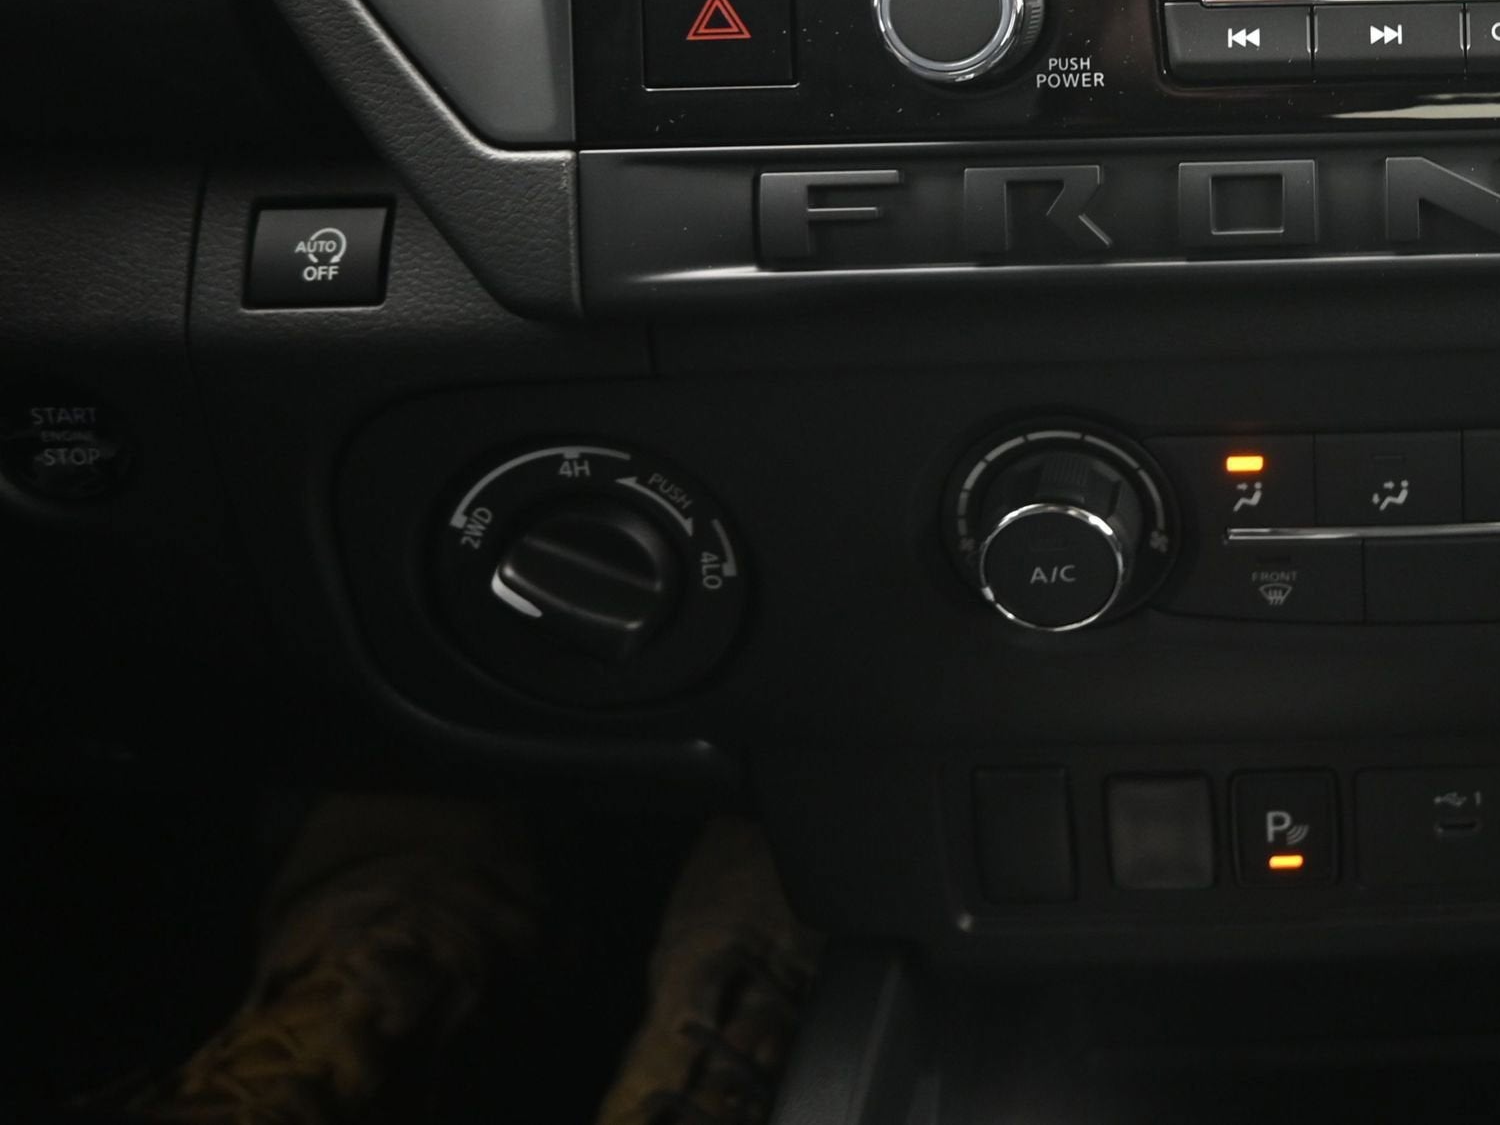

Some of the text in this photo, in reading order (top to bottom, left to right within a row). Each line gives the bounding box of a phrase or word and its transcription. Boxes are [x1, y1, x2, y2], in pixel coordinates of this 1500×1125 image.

[1047, 56, 1092, 72] PUSH
[1035, 72, 1105, 89] POWER
[293, 239, 338, 254] AUTO
[301, 264, 340, 282] OFF
[29, 406, 97, 425] START
[42, 447, 101, 466] STOP
[558, 460, 591, 478] 4H
[648, 472, 694, 510] PUSH
[460, 506, 494, 550] 2WD
[701, 550, 723, 590] 4LO
[1029, 563, 1076, 584] A/C
[1251, 570, 1298, 583] FRONT
[1265, 810, 1292, 844] P
